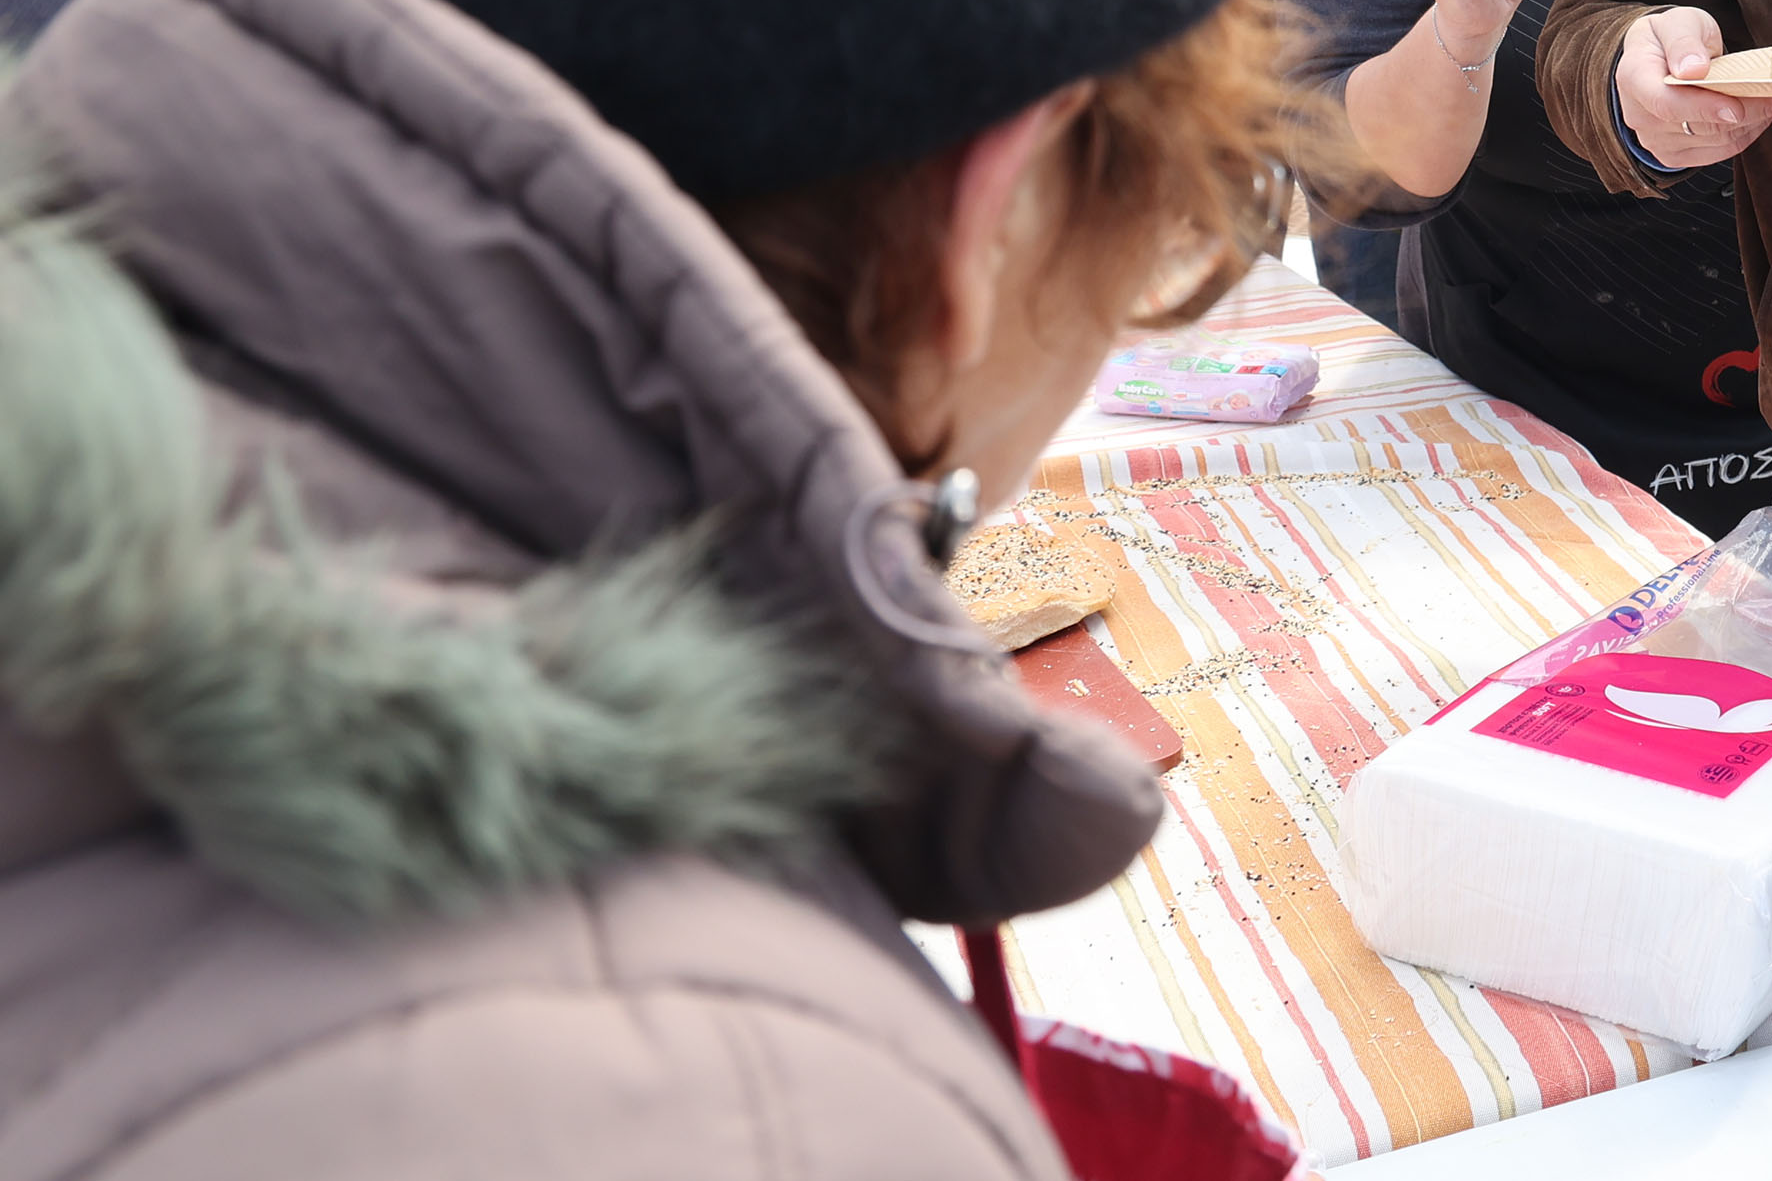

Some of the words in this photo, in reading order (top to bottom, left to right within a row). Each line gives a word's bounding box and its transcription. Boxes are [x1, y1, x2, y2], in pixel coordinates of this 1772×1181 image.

[1118, 383, 1141, 395] Baby
[1142, 385, 1164, 396] Care
[1655, 562, 1706, 620] Professional
[1702, 548, 1721, 569] Line
